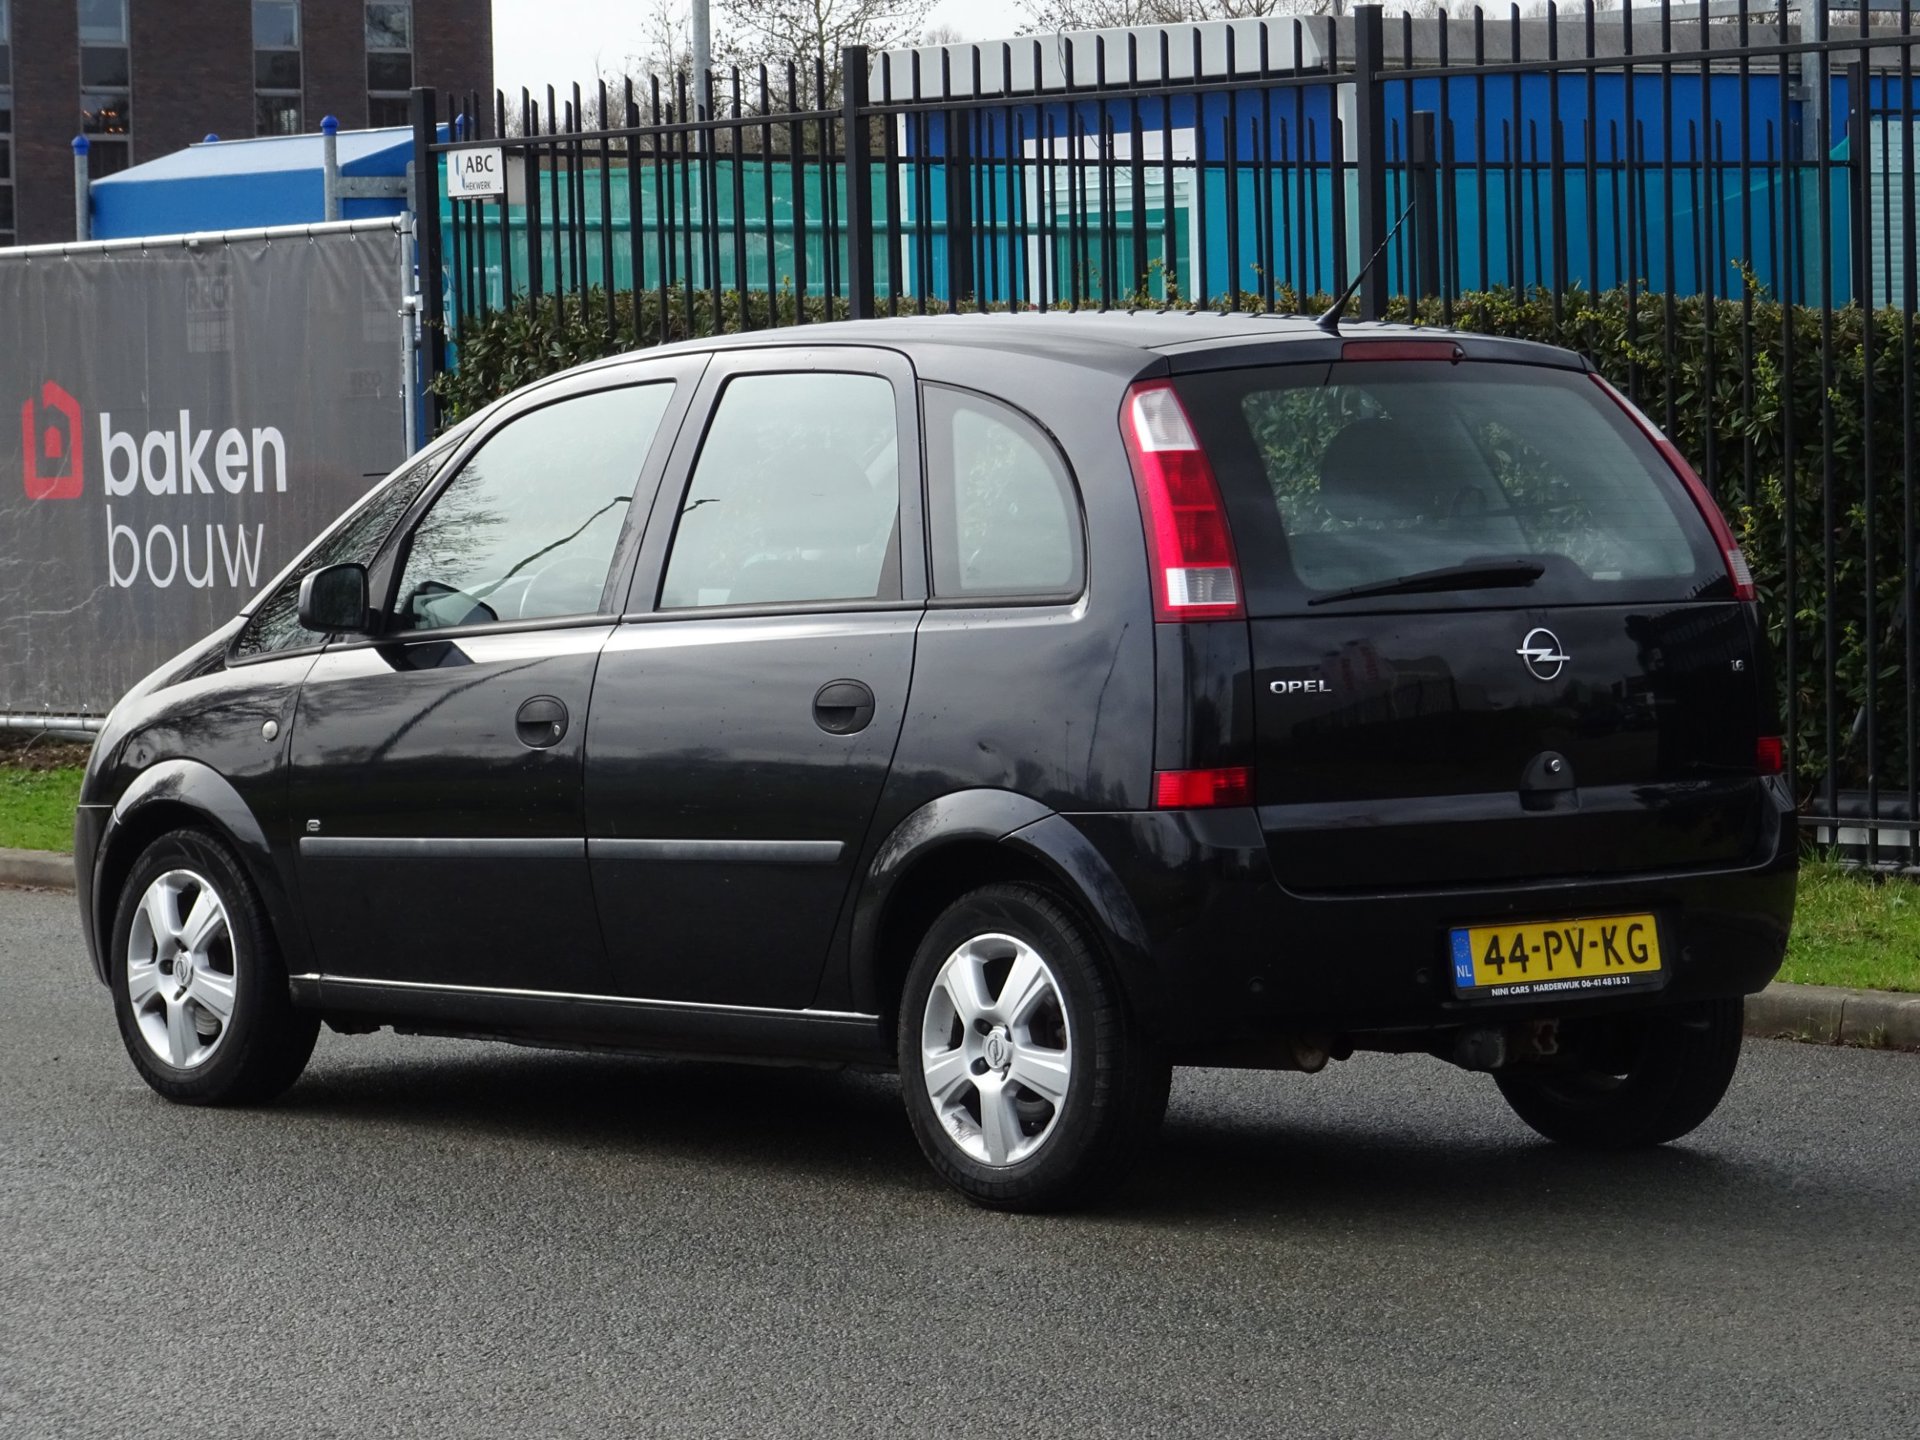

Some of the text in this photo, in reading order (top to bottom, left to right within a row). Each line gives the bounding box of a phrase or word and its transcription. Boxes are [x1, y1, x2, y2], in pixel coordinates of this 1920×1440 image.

[465, 154, 493, 173] ABC
[465, 181, 492, 191] HEKWERK
[100, 409, 287, 496] baken
[106, 504, 264, 588] bouw
[1269, 678, 1332, 695] OPEL
[1483, 923, 1649, 976] 44-PV-KG
[1456, 964, 1472, 978] NL
[1491, 987, 1509, 997] NINI
[1510, 985, 1530, 995] CARS
[1533, 980, 1580, 993] HARDERWIJK
